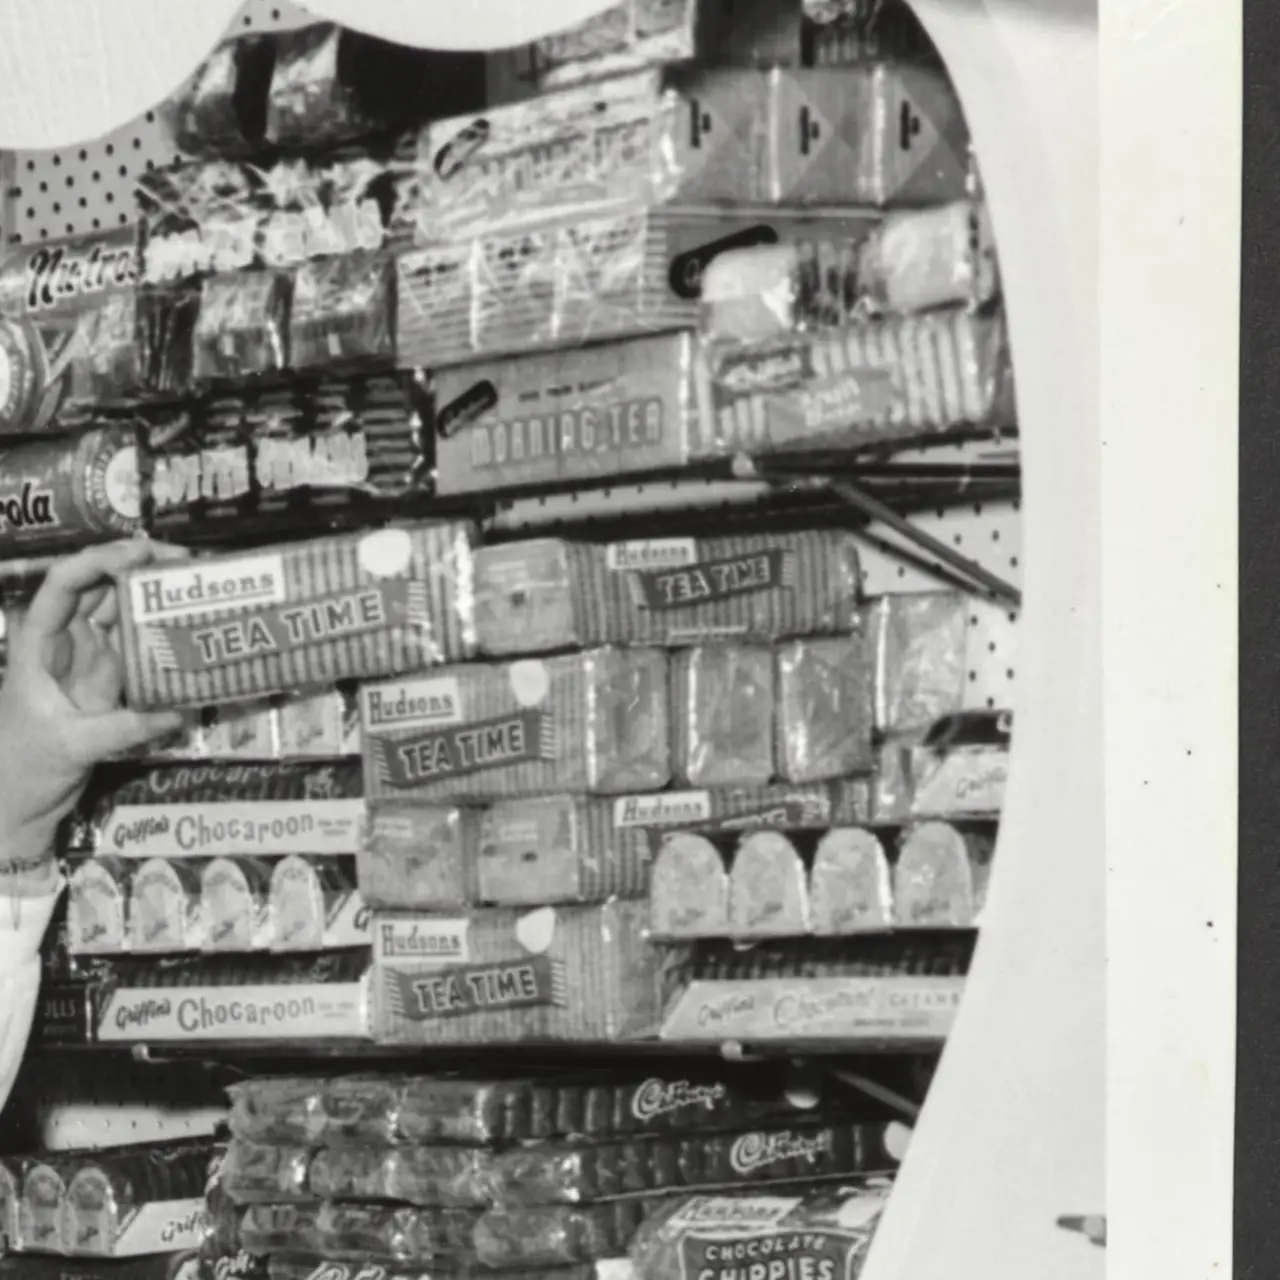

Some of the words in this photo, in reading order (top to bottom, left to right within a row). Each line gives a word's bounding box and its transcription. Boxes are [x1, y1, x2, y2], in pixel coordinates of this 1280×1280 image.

[471, 404, 595, 468] MORNING
[606, 399, 663, 446] TEA
[140, 569, 276, 616] Hudsons
[655, 568, 711, 603] TEA
[712, 556, 770, 593] TIME
[195, 620, 273, 665] TEA
[286, 591, 384, 642] TIME
[367, 684, 454, 717] Hudsons
[401, 740, 453, 779] TEA
[455, 722, 524, 761] TIME
[174, 812, 315, 851] Chocaroon
[381, 924, 460, 955] Hudsons
[417, 976, 462, 1012] TEA
[468, 962, 538, 1001] TIME
[177, 996, 316, 1034] Chocaroon
[705, 1237, 825, 1261] CHOCOLATE
